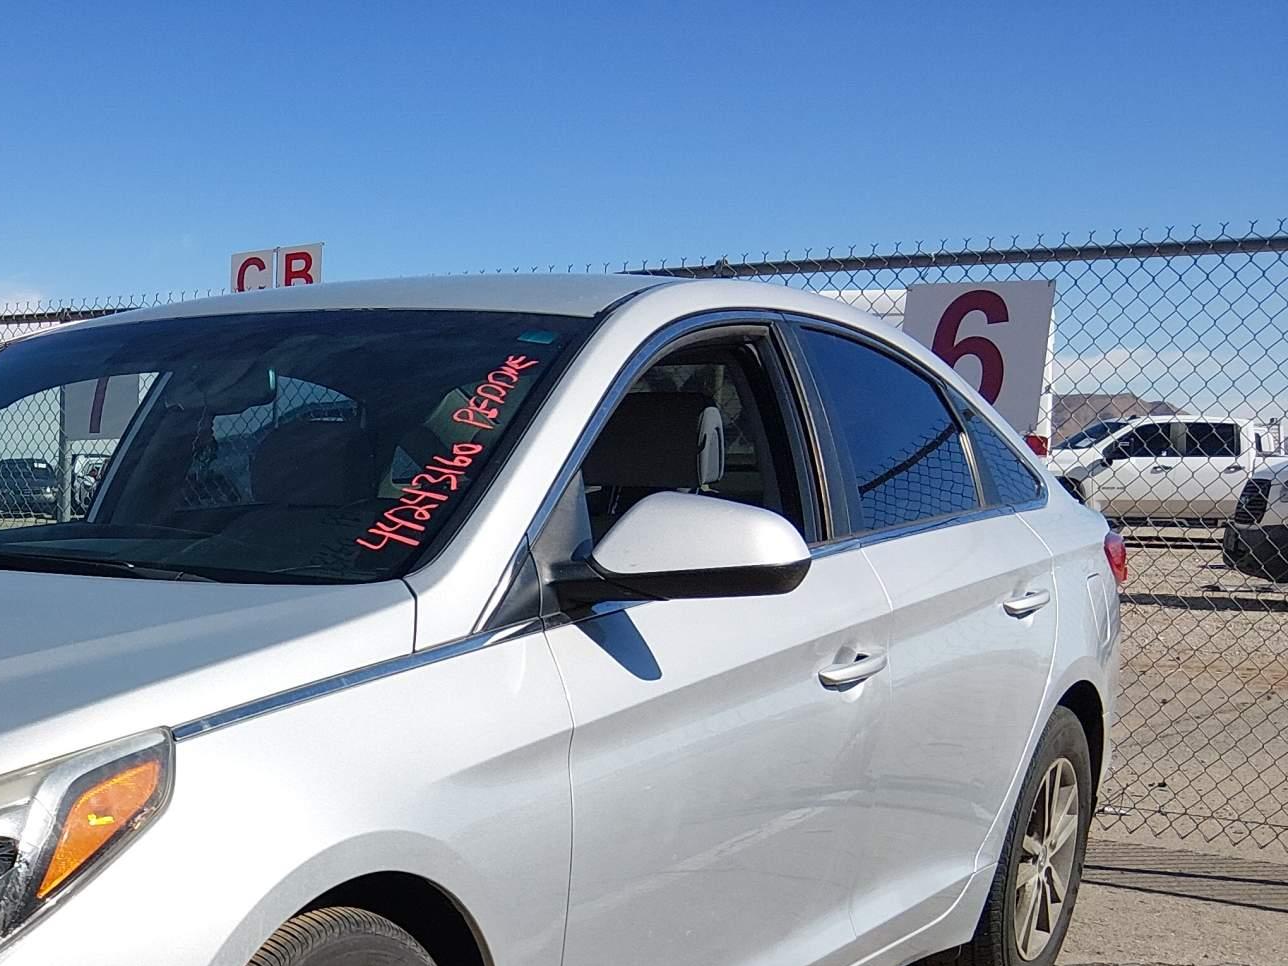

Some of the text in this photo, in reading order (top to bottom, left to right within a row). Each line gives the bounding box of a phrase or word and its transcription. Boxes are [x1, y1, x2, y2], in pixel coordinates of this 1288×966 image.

[237, 256, 266, 292] C
[931, 289, 1009, 405] 6
[356, 444, 483, 549] 44243160
